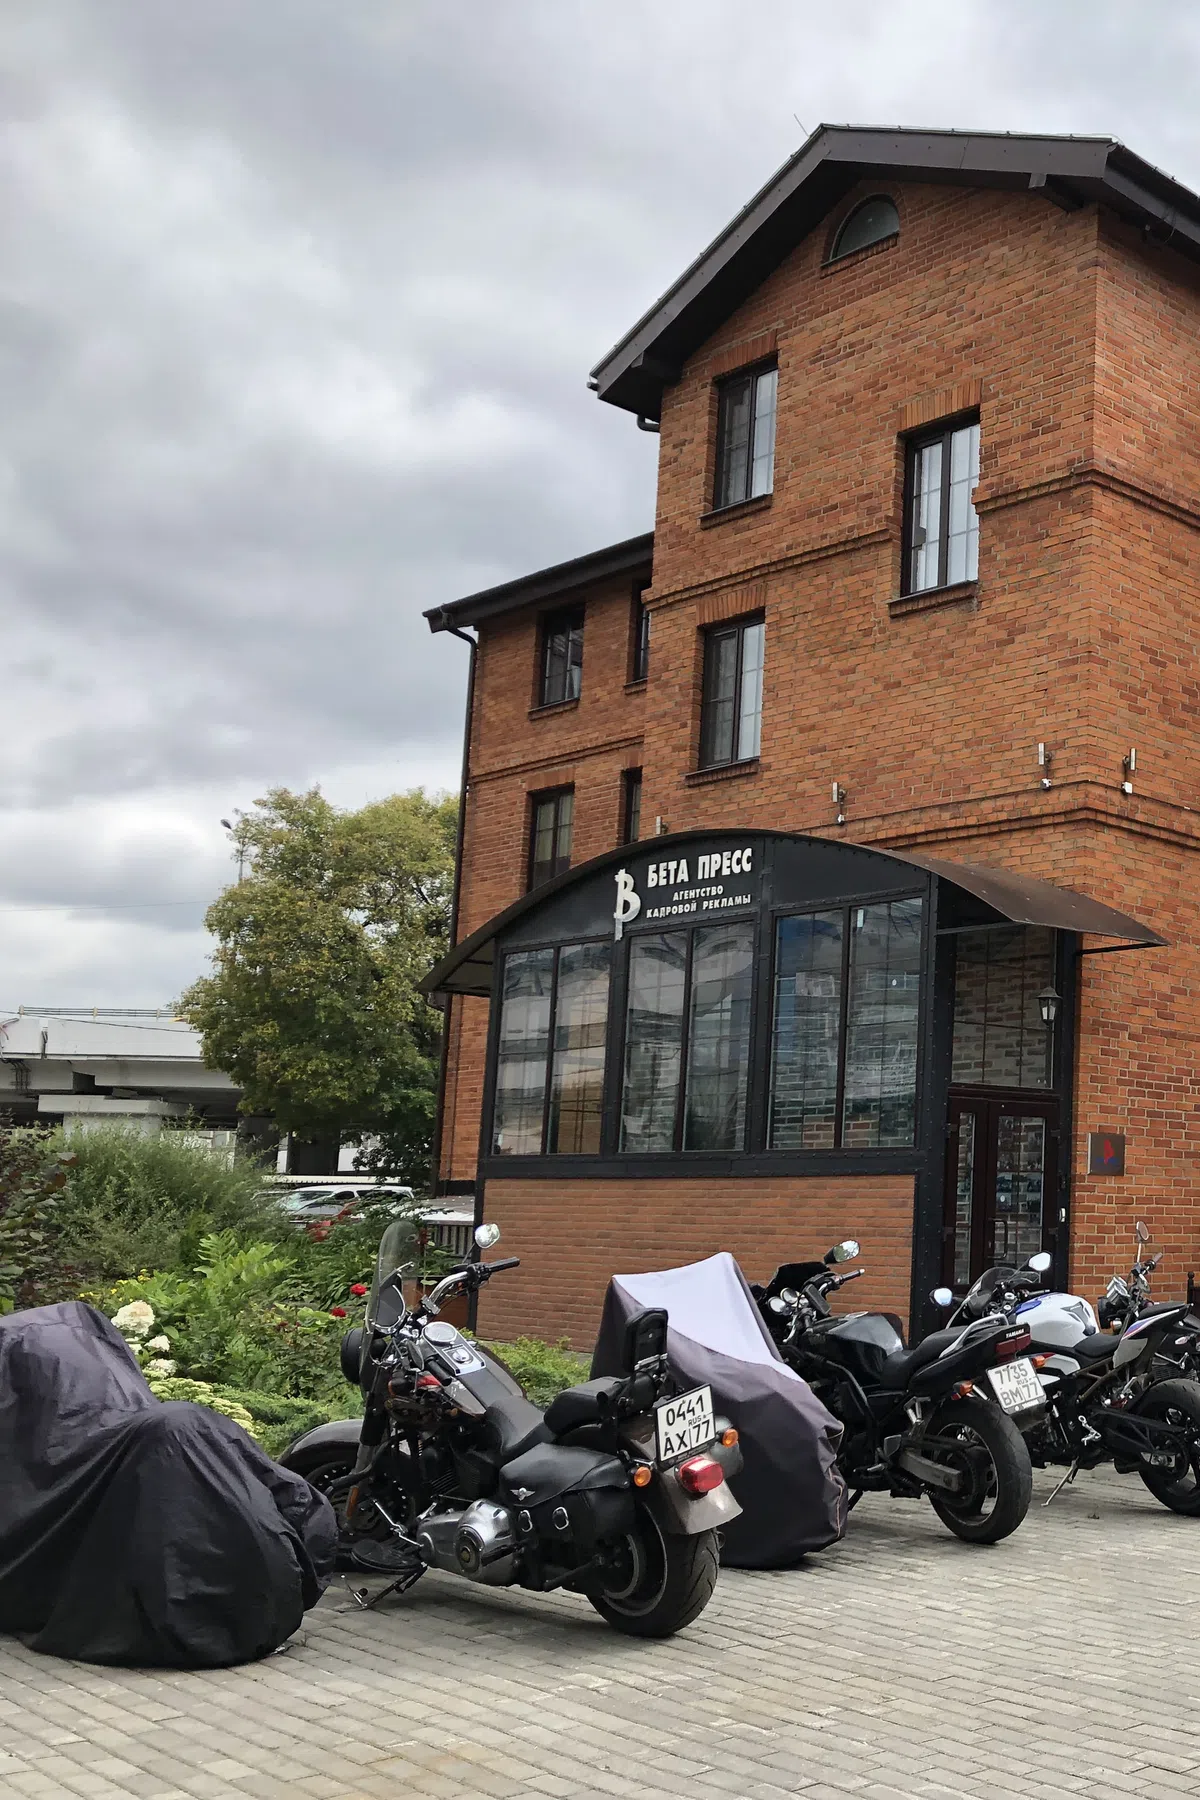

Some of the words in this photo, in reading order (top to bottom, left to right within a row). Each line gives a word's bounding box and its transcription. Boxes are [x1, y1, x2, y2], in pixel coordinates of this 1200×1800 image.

[647, 859, 689, 888] БЕТА
[698, 848, 752, 880] ПРЕСС
[673, 885, 724, 901] АГЕНТСТВО
[646, 901, 697, 919] КАДРОВОЙ
[702, 894, 751, 911] РЕКЛАМЫ
[995, 1363, 1028, 1384] 7735
[1022, 1382, 1038, 1398] 77
[666, 1394, 704, 1426] 0441
[688, 1415, 702, 1427] RUS
[693, 1419, 710, 1443] 77
